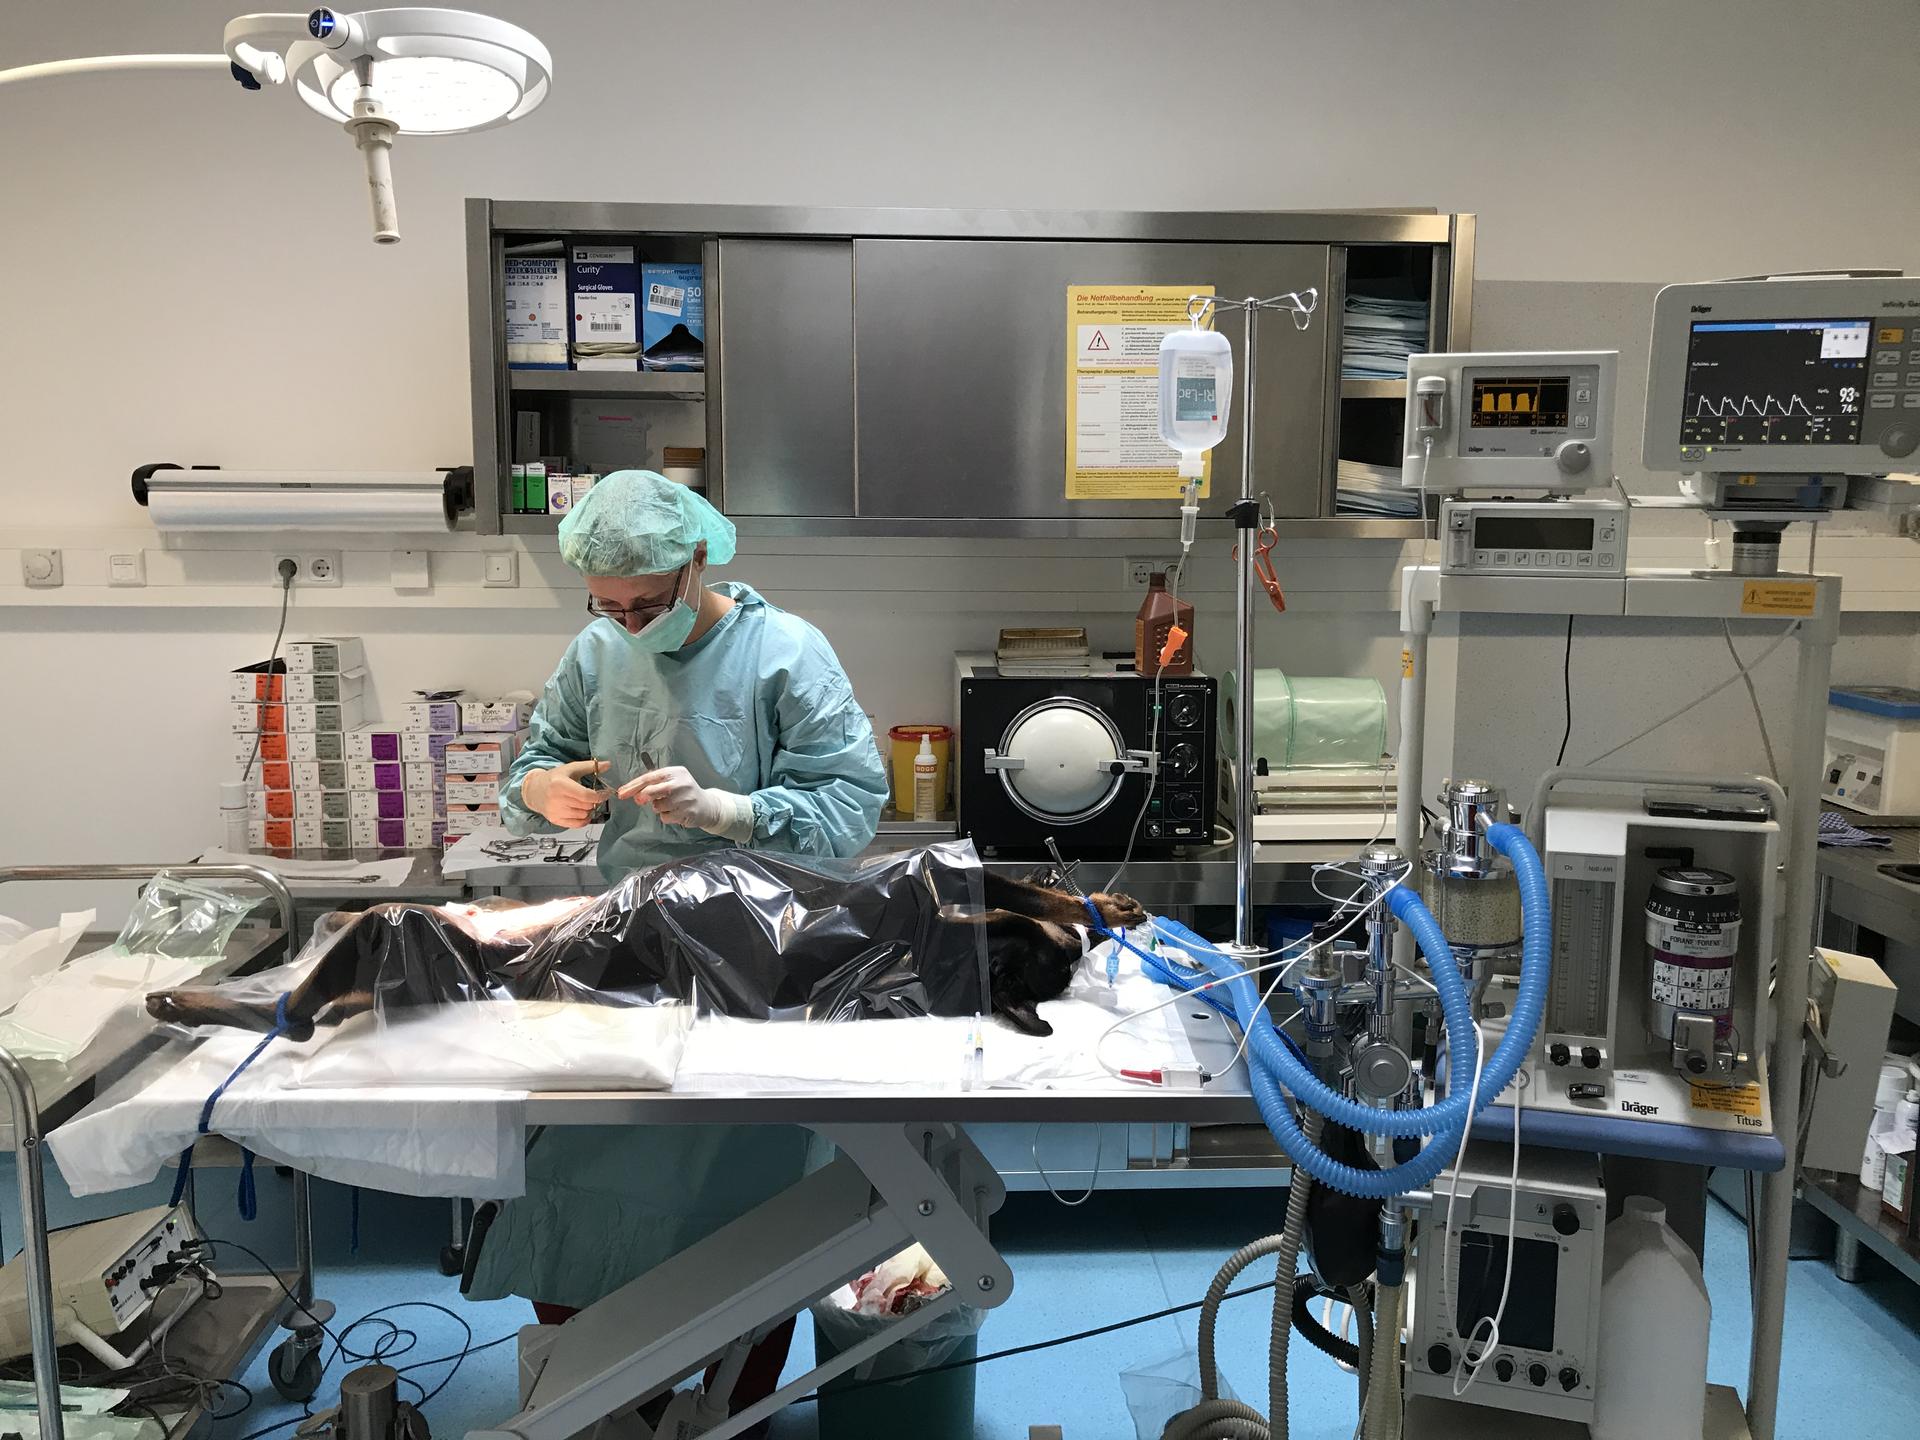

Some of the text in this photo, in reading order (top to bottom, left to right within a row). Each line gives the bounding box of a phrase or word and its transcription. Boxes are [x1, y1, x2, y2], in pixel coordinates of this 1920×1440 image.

[687, 287, 701, 296] 50
[1690, 305, 1712, 314] Dräger
[1178, 388, 1215, 402] Ri-Lac
[1840, 387, 1855, 402] 93
[1842, 404, 1852, 414] 74
[1670, 936, 1692, 944] FORANE
[1622, 1100, 1658, 1116] Dräger
[1734, 1114, 1762, 1127] Titus
